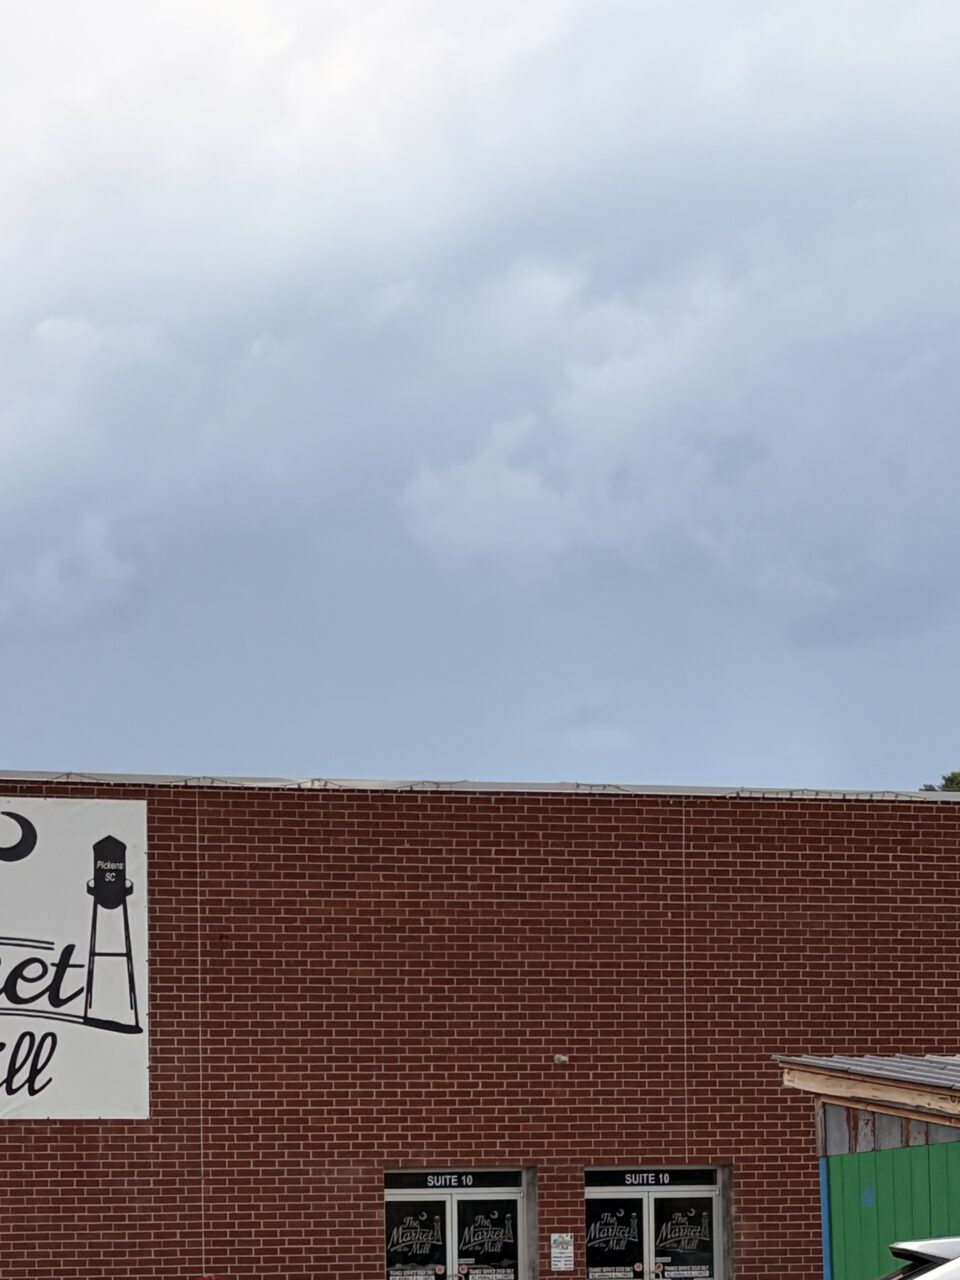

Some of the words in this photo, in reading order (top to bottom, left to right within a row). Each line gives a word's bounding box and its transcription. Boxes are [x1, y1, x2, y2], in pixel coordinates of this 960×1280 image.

[96, 860, 125, 871] Pickens
[104, 872, 117, 882] SC
[426, 1174, 459, 1186] SUITE
[461, 1174, 474, 1186] 10
[625, 1173, 656, 1184] SUITE
[658, 1173, 670, 1184] 10
